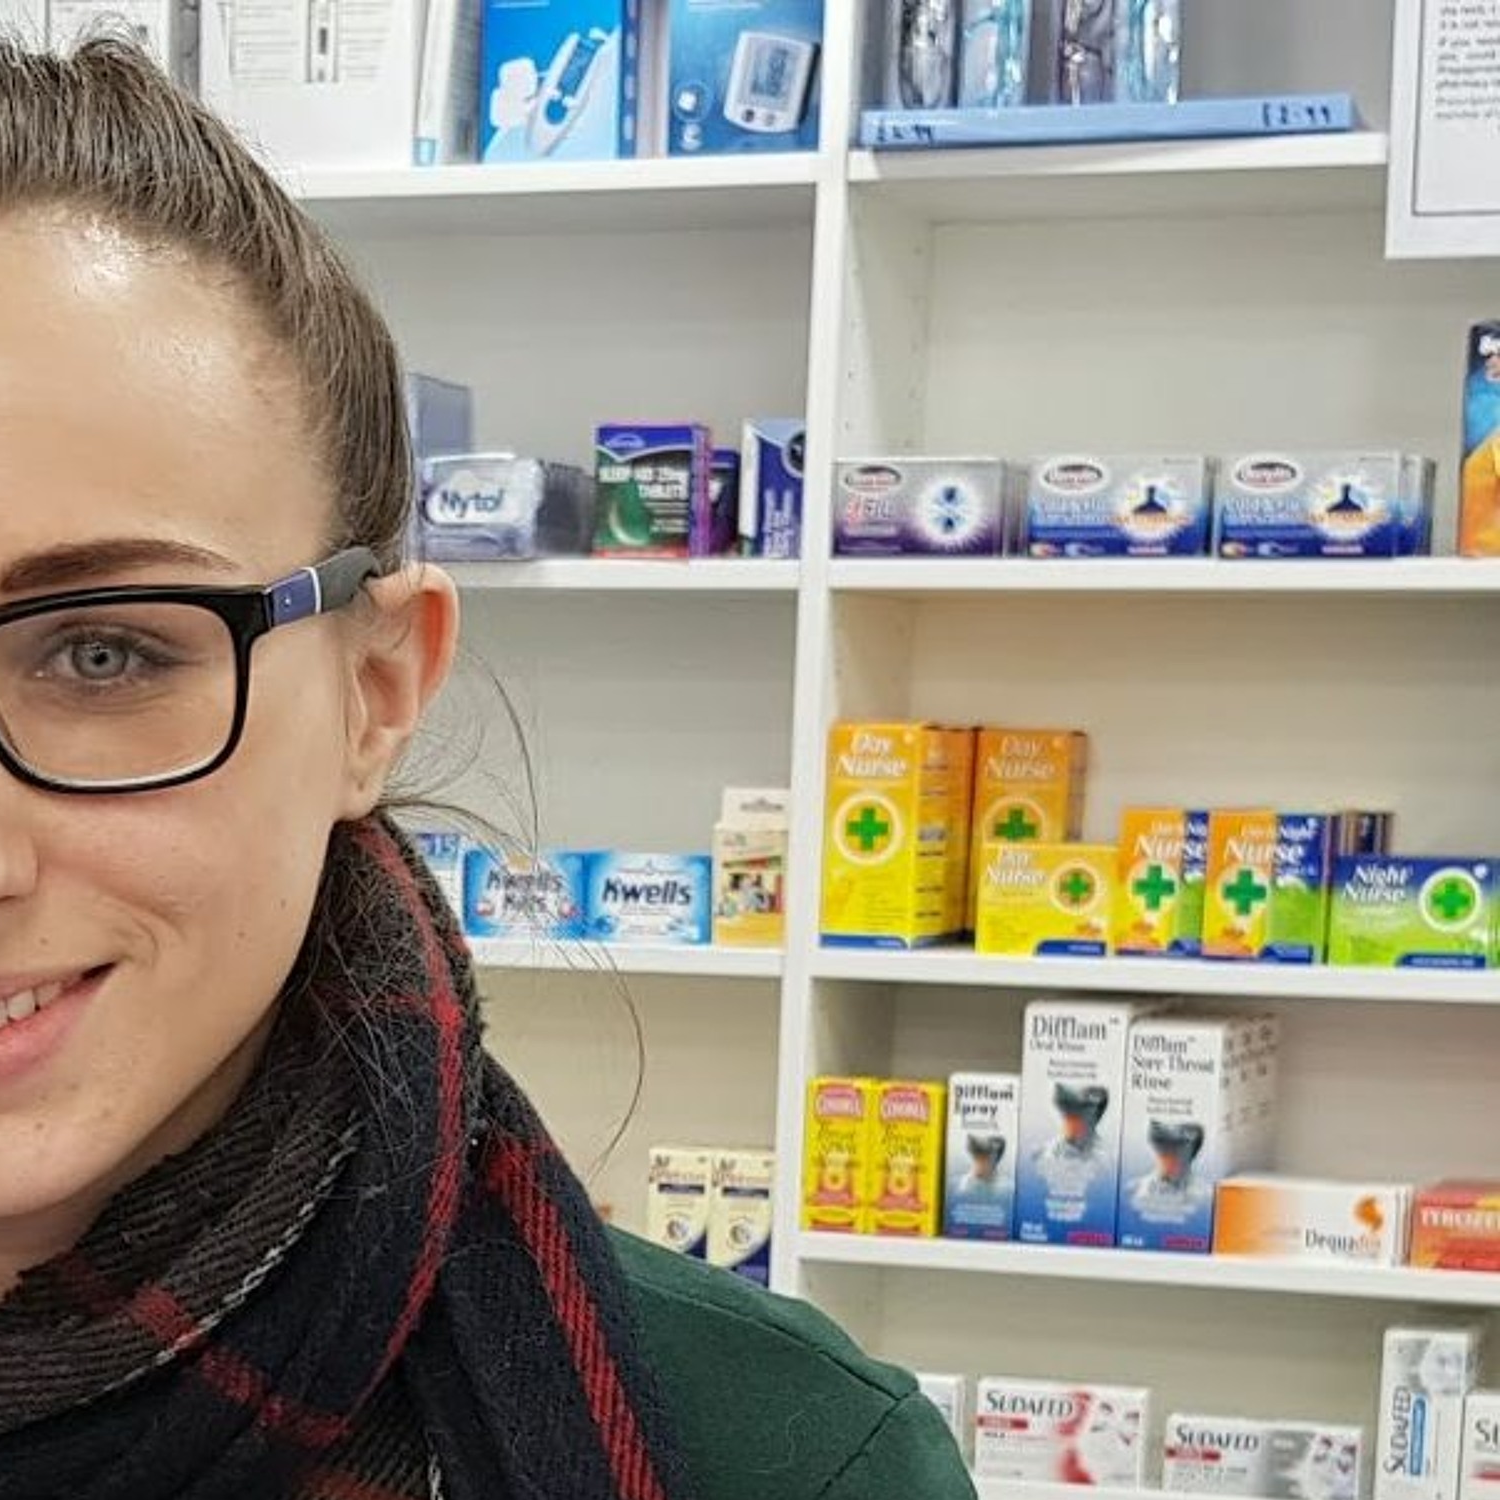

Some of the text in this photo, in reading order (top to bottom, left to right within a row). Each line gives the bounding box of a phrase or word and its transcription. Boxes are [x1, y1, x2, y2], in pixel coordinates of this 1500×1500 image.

[439, 488, 504, 517] Nytol
[836, 753, 907, 779] Nurse
[601, 877, 692, 907] Kwells
[1031, 1016, 1108, 1040] Difflam
[1133, 1034, 1189, 1054] Difflam
[986, 1389, 1073, 1417] SUDAFED
[1175, 1425, 1259, 1452] SUDAFED
[1384, 1386, 1412, 1475] SUDAFED
